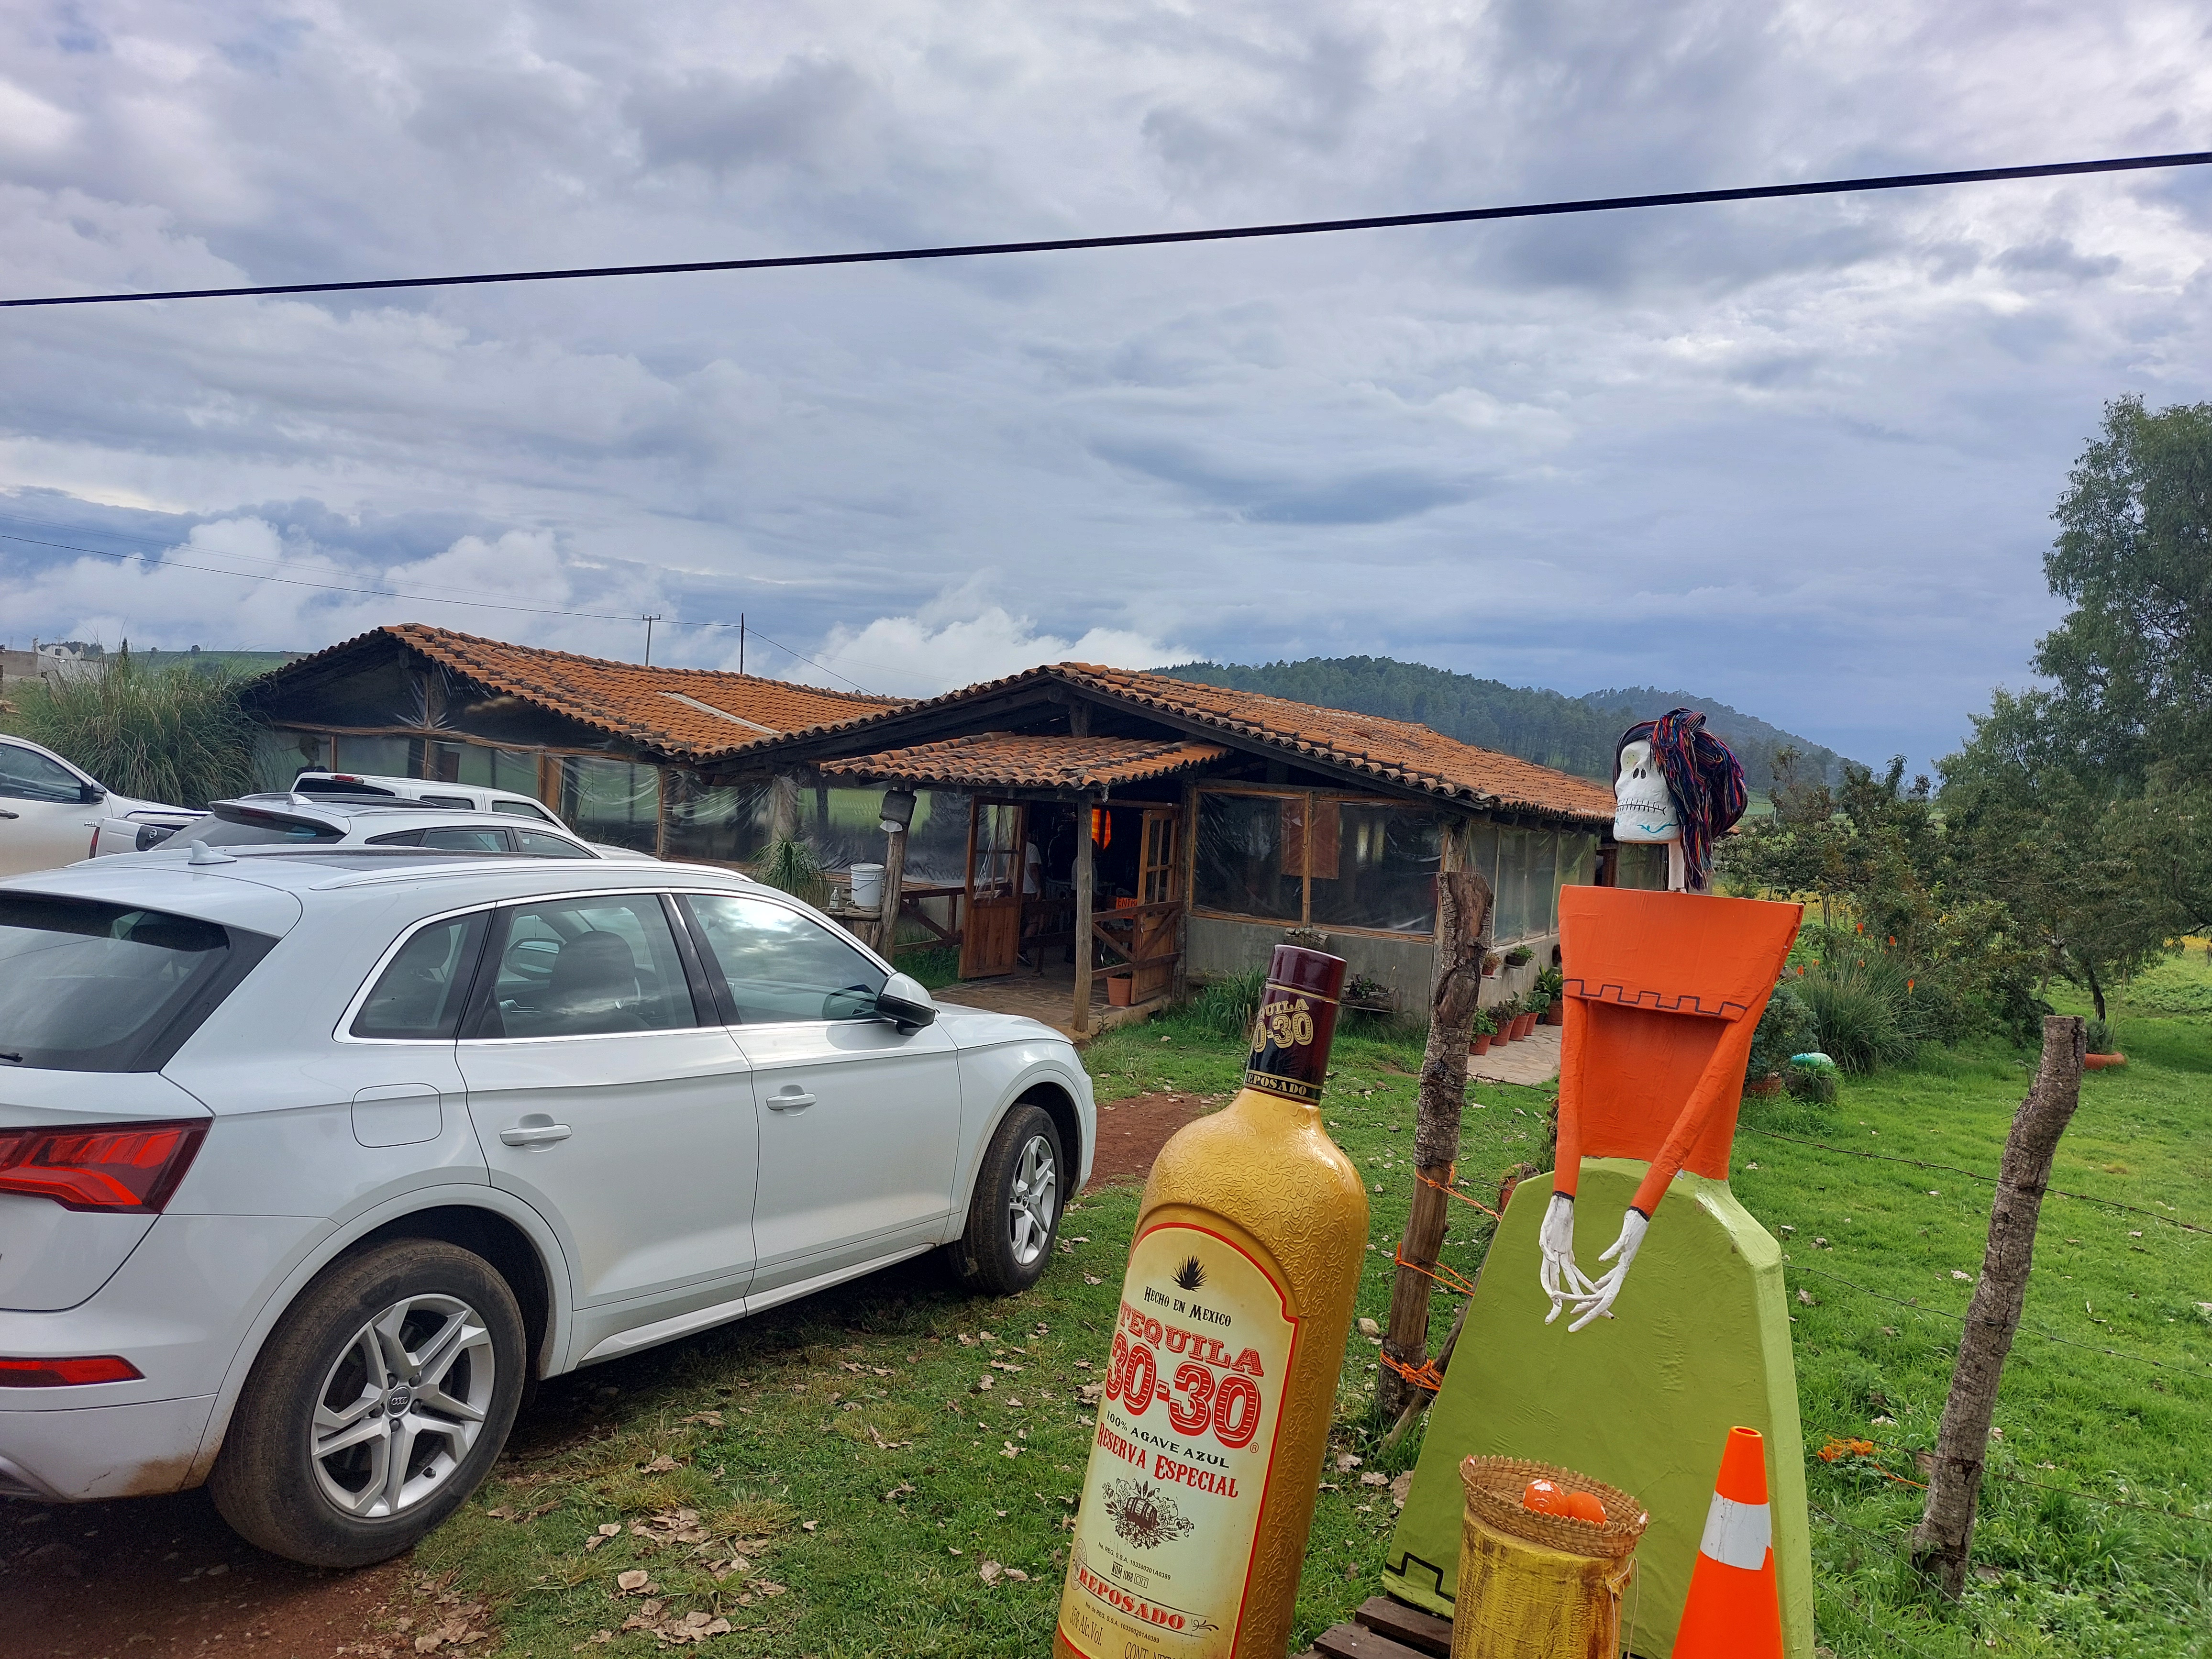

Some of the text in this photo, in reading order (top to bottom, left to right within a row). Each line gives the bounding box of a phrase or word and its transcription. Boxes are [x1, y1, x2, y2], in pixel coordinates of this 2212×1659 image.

[1258, 998, 1309, 1019] QUILA
[1253, 1011, 1314, 1052] 0-30
[1143, 1286, 1232, 1327] HECHO EN MEXICO
[1119, 1300, 1264, 1376] TEQUILA
[1106, 1329, 1262, 1449] 30-30
[1097, 1422, 1239, 1498] RESERVA ESPECIAL
[1106, 1410, 1229, 1469] 100% AGAVE AZUL
[1105, 1546, 1115, 1557] REG.
[1116, 1552, 1128, 1563] S.S.A.
[1130, 1559, 1171, 1580] 103300201A0389
[1111, 1562, 1148, 1587] NOM 1068 CRT
[1078, 1568, 1186, 1630] REPOSADO
[1096, 1609, 1105, 1620] REG.
[1106, 1615, 1119, 1627] S.S.A.
